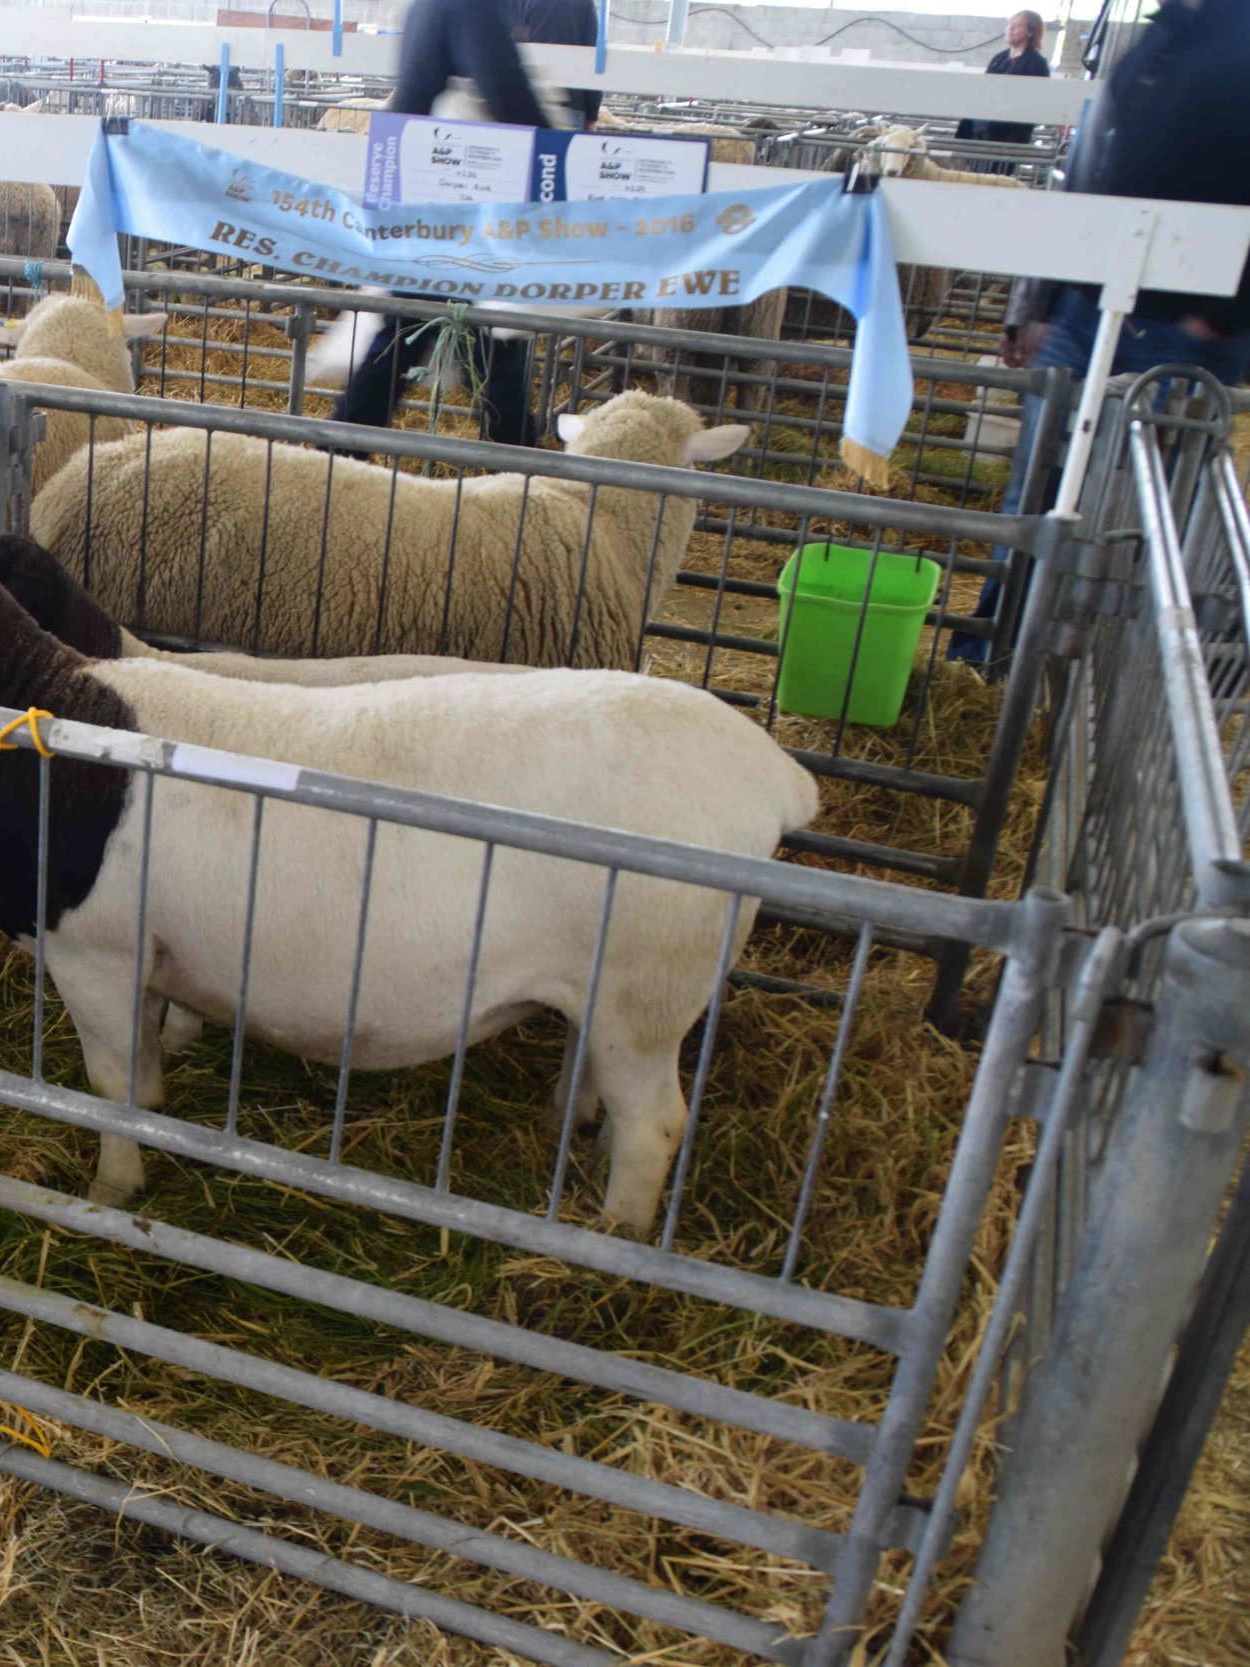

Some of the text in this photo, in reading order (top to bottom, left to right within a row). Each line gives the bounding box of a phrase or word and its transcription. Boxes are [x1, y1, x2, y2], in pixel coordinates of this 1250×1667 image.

[366, 142, 384, 203] Reserve
[378, 136, 398, 210] Champion
[430, 155, 462, 166] SHOW
[431, 147, 453, 156] A&P
[598, 170, 632, 181] SHOW
[599, 162, 622, 170] A&P
[538, 154, 557, 202] cond
[271, 190, 335, 223] 154th
[342, 211, 475, 246] Canterbury
[481, 219, 531, 239] A&P
[538, 217, 610, 240] Show
[633, 213, 695, 237] 2016
[209, 220, 741, 300] RES. CHAMPION DORPER EWE
